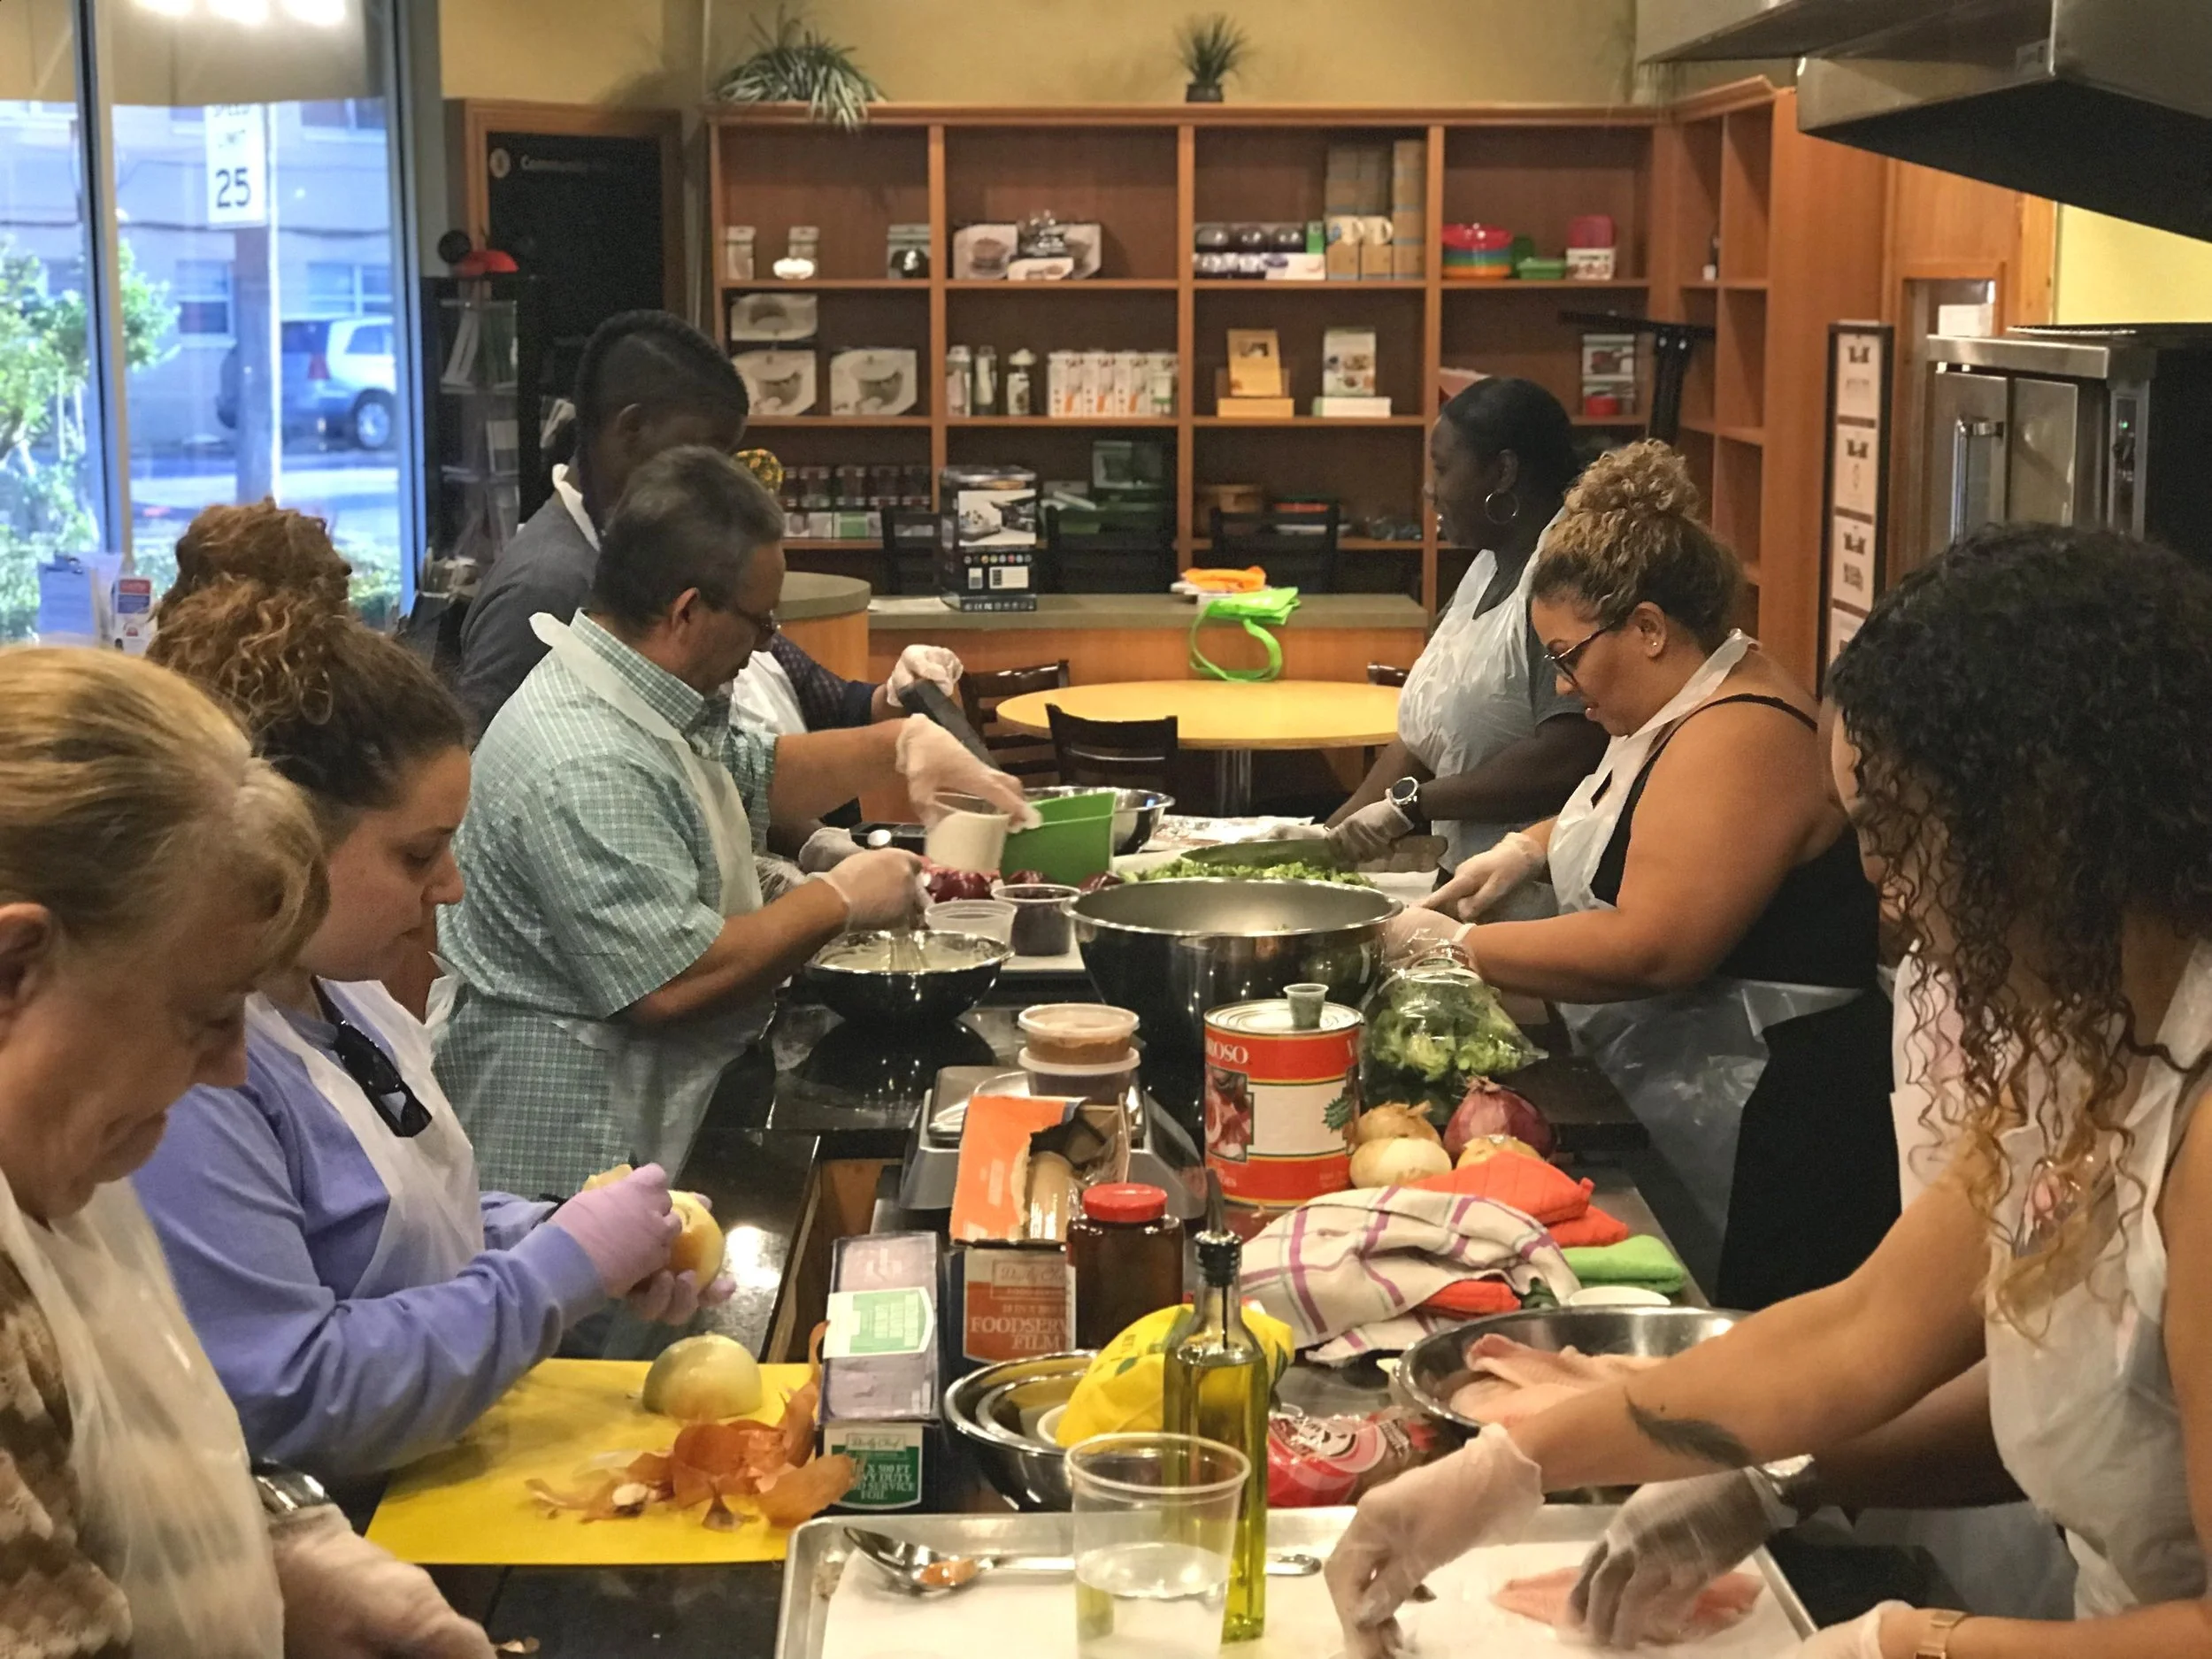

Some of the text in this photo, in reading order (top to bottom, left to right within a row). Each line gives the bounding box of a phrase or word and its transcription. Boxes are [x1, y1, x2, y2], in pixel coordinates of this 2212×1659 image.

[215, 166, 250, 208] 25
[970, 1317, 1066, 1333] FOODSERV
[1011, 1334, 1060, 1350] FILM
[879, 1473, 912, 1483] DUTY
[860, 1491, 887, 1500] FOIL
